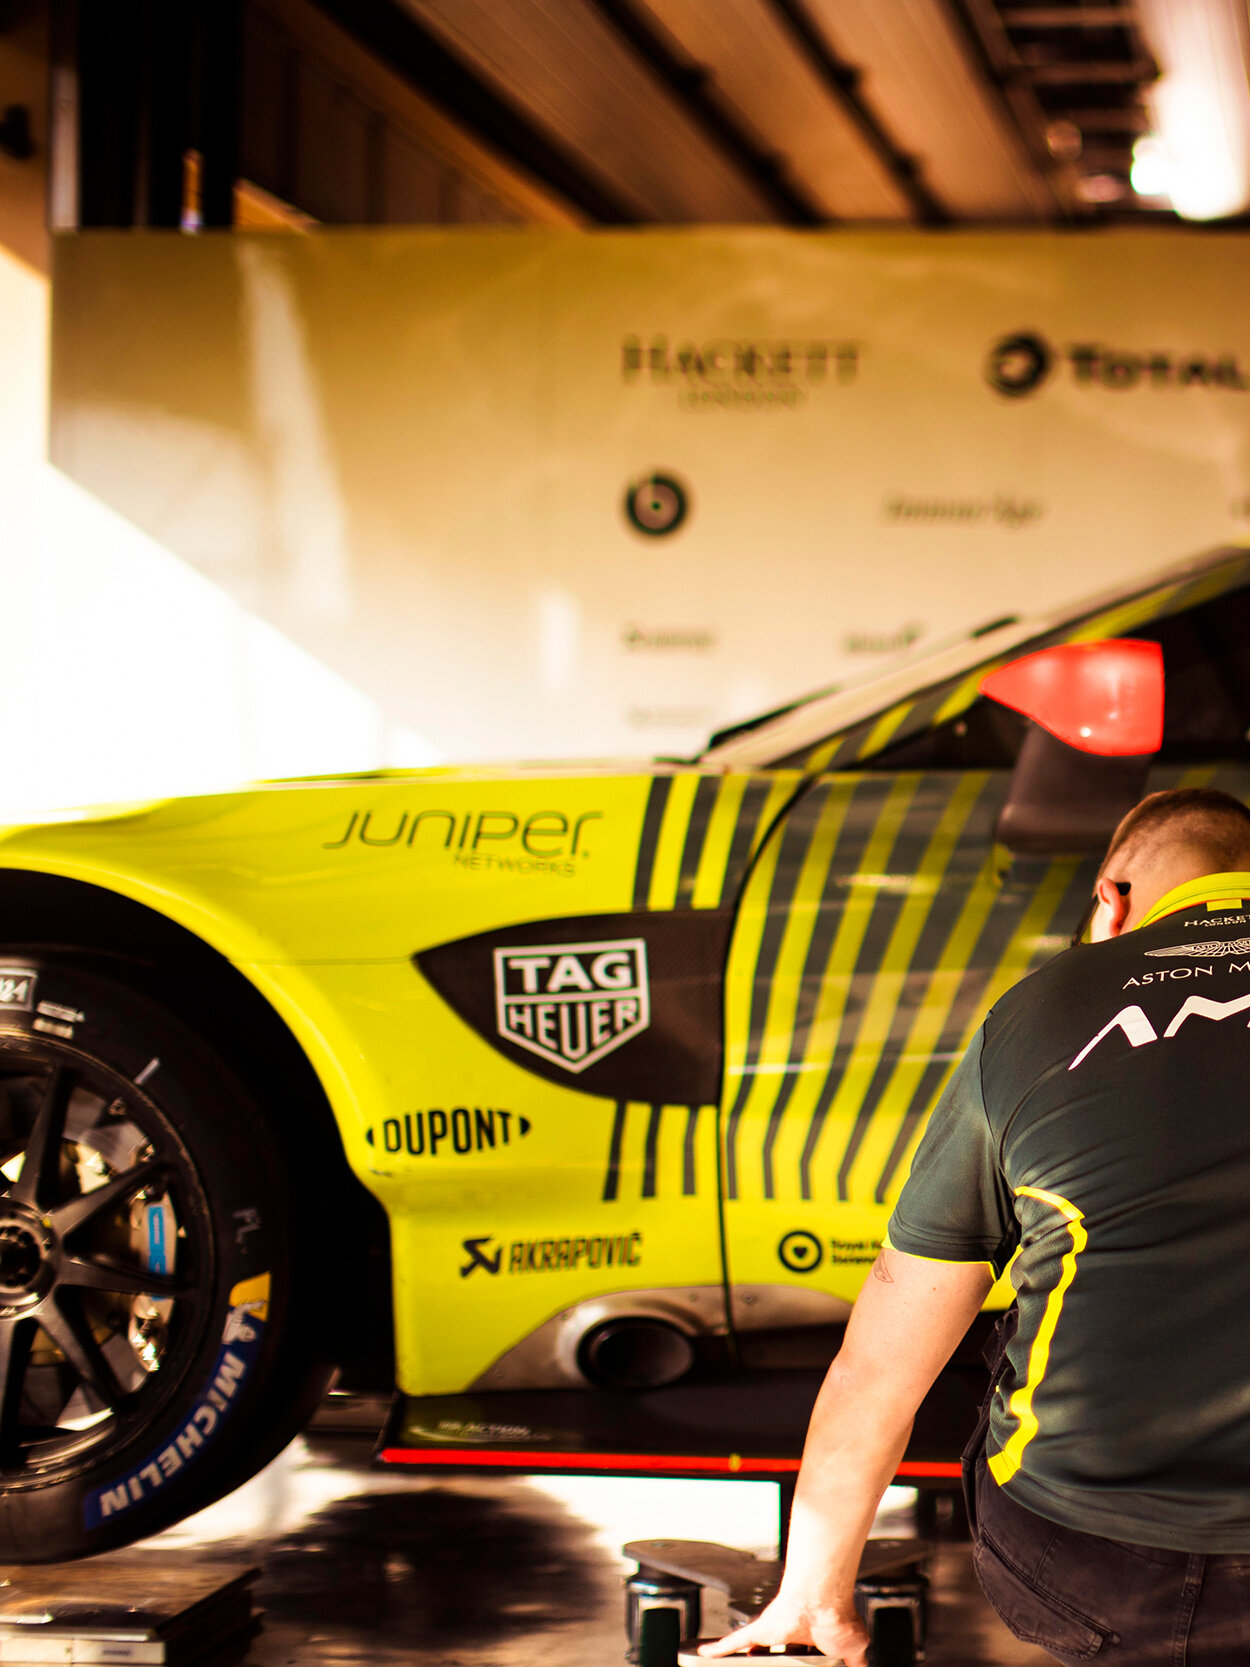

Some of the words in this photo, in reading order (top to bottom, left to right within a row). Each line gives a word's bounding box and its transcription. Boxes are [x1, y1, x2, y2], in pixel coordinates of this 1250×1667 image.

[454, 852, 577, 878] NETWORKS
[1204, 919, 1247, 927] LONDON
[508, 951, 633, 994] TAG
[1122, 965, 1214, 990] ASTON
[508, 999, 638, 1061] HEUER
[383, 1109, 513, 1156] DUPONT
[99, 1351, 247, 1517] MICHELIN
